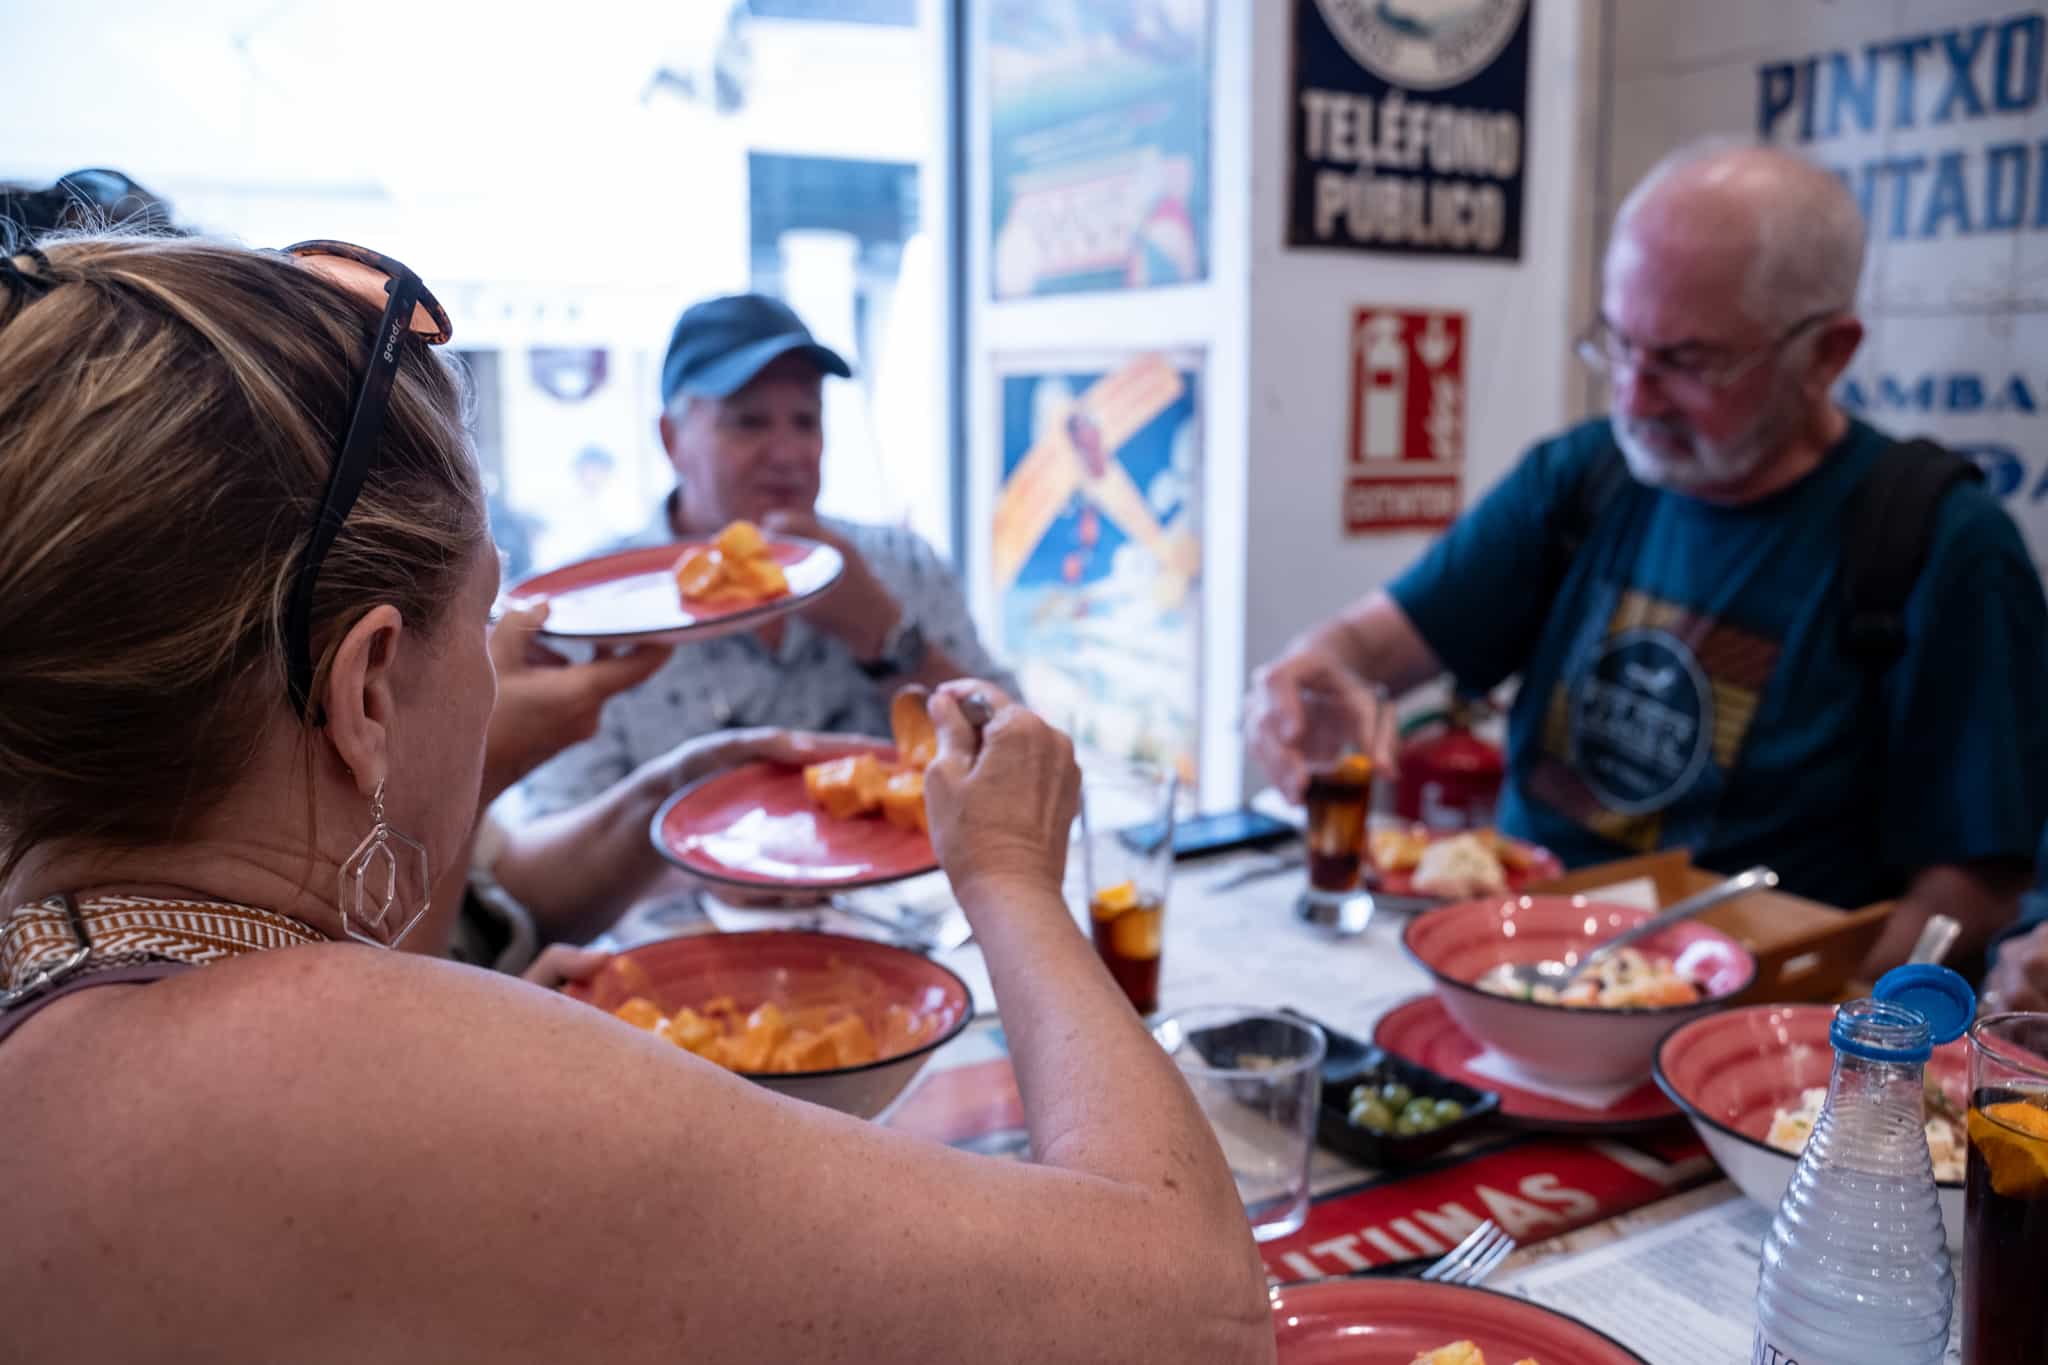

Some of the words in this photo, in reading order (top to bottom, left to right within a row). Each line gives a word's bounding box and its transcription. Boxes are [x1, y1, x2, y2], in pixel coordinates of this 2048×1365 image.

[1757, 13, 2046, 146] PINTXO
[1302, 88, 1520, 179] TELÉFONO
[1315, 166, 1506, 249] PÚBLICO
[383, 320, 401, 363] goodr
[1263, 1175, 1597, 1280] ITUNAS
[1768, 1344, 1799, 1365] T
